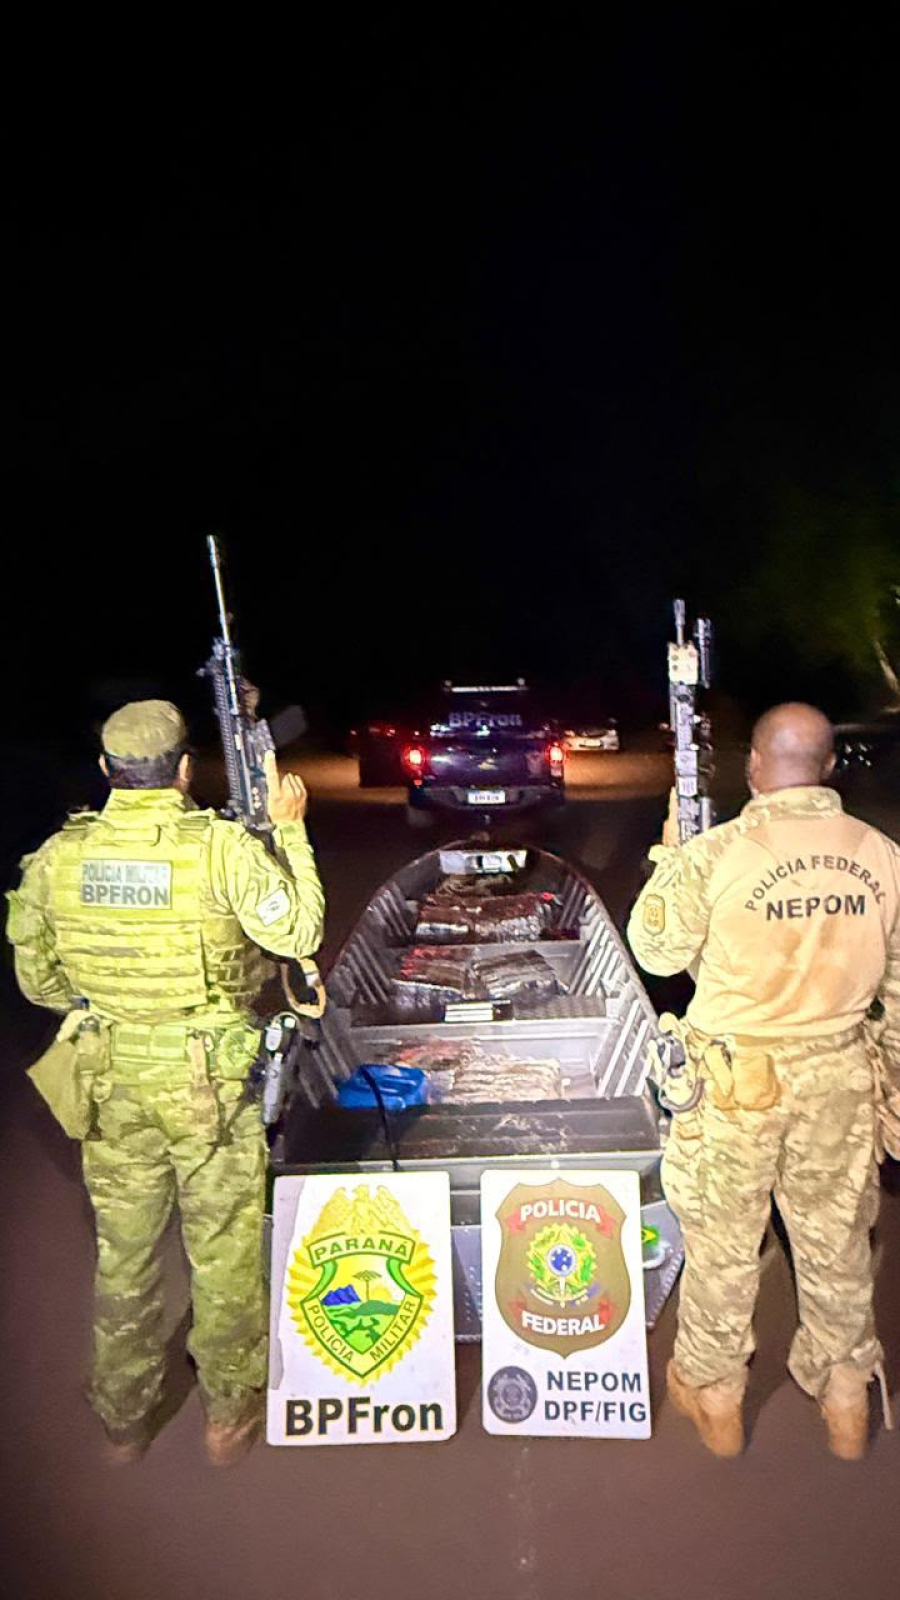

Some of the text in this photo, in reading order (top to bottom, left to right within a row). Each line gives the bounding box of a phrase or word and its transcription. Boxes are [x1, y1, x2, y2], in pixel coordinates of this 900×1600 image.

[810, 855, 886, 905] FEDERAL
[81, 884, 169, 906] BPFRON
[766, 894, 866, 921] NEPOM
[520, 1199, 601, 1224] POLICIA
[308, 1300, 416, 1363] POLICIA MILITAR
[521, 1310, 606, 1336] FEDERAL
[546, 1370, 642, 1393] NEPOM
[284, 1396, 444, 1437] BPFron
[544, 1400, 647, 1423] DPF/FIG
